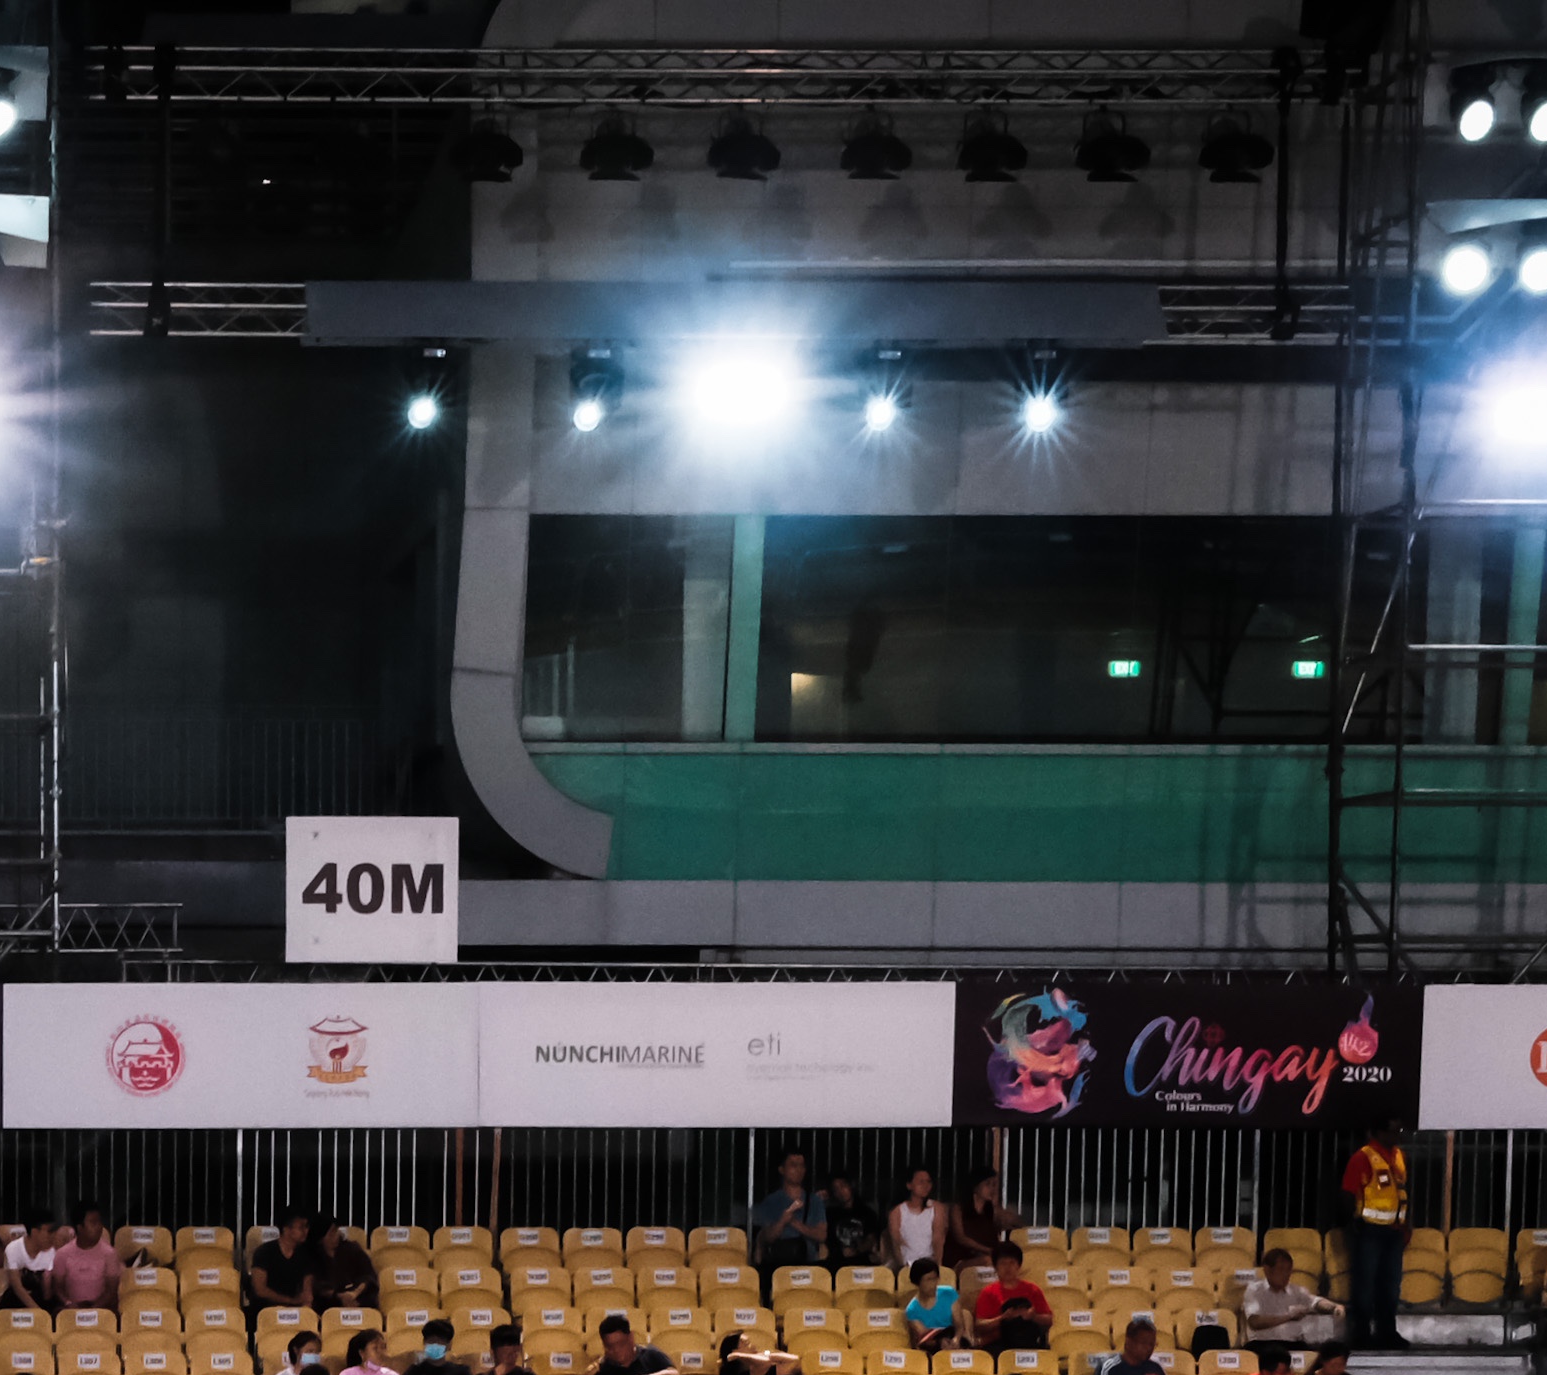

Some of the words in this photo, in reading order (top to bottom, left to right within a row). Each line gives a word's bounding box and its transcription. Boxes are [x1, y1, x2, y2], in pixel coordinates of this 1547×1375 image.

[301, 864, 446, 916] 40M
[747, 1032, 781, 1056] eti
[1124, 1015, 1340, 1115] Chingay
[1342, 1066, 1392, 1083] 2020
[1155, 1090, 1202, 1101] Colours
[1166, 1101, 1177, 1112] in
[1180, 1101, 1235, 1114] Harmony
